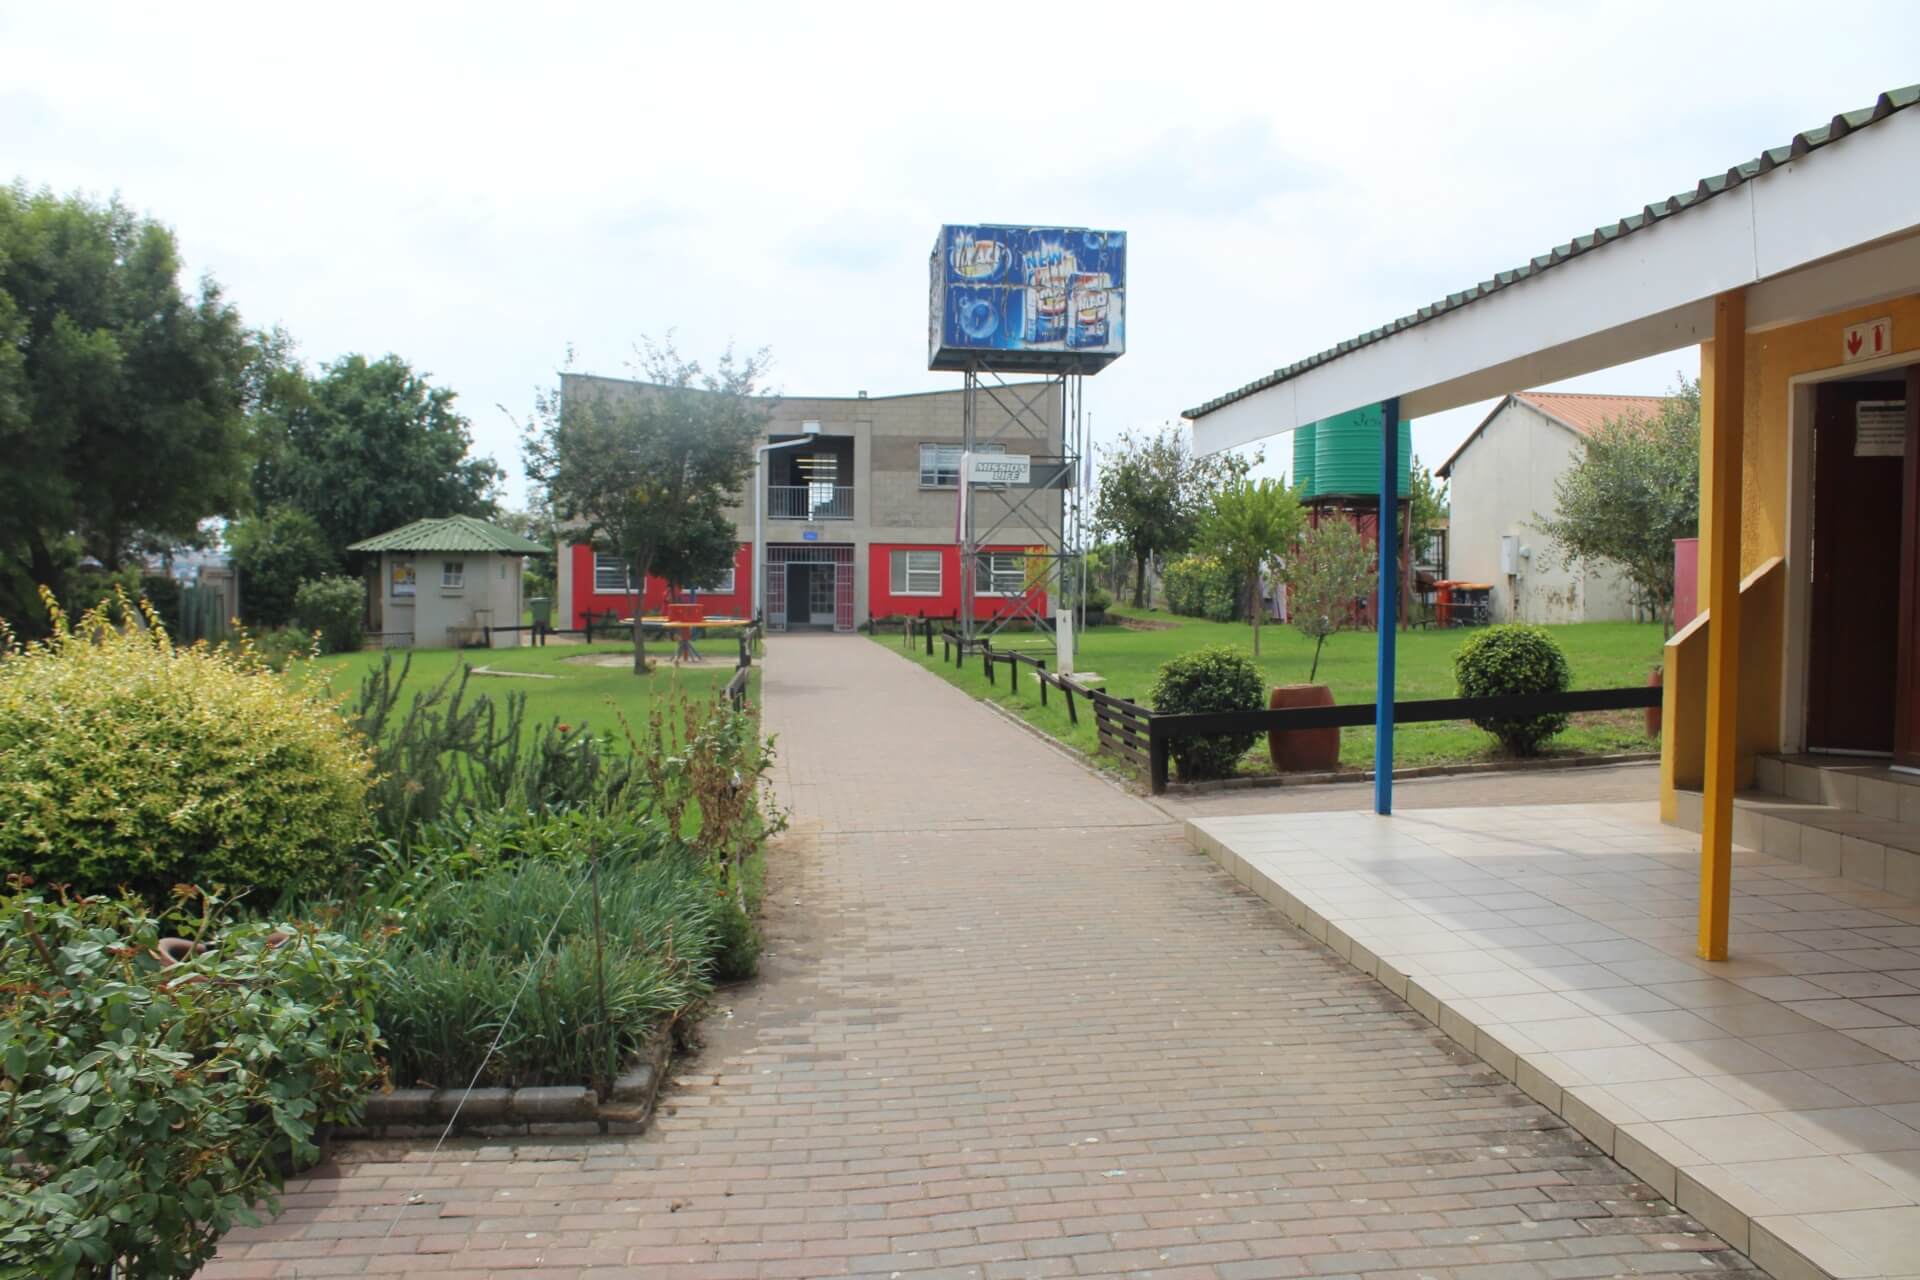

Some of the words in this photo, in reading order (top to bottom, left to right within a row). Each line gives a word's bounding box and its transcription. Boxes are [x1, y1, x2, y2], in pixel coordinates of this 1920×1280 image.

[1026, 251, 1063, 269] NEW
[976, 462, 1027, 472] MISSION
[992, 472, 1020, 480] LIFE
